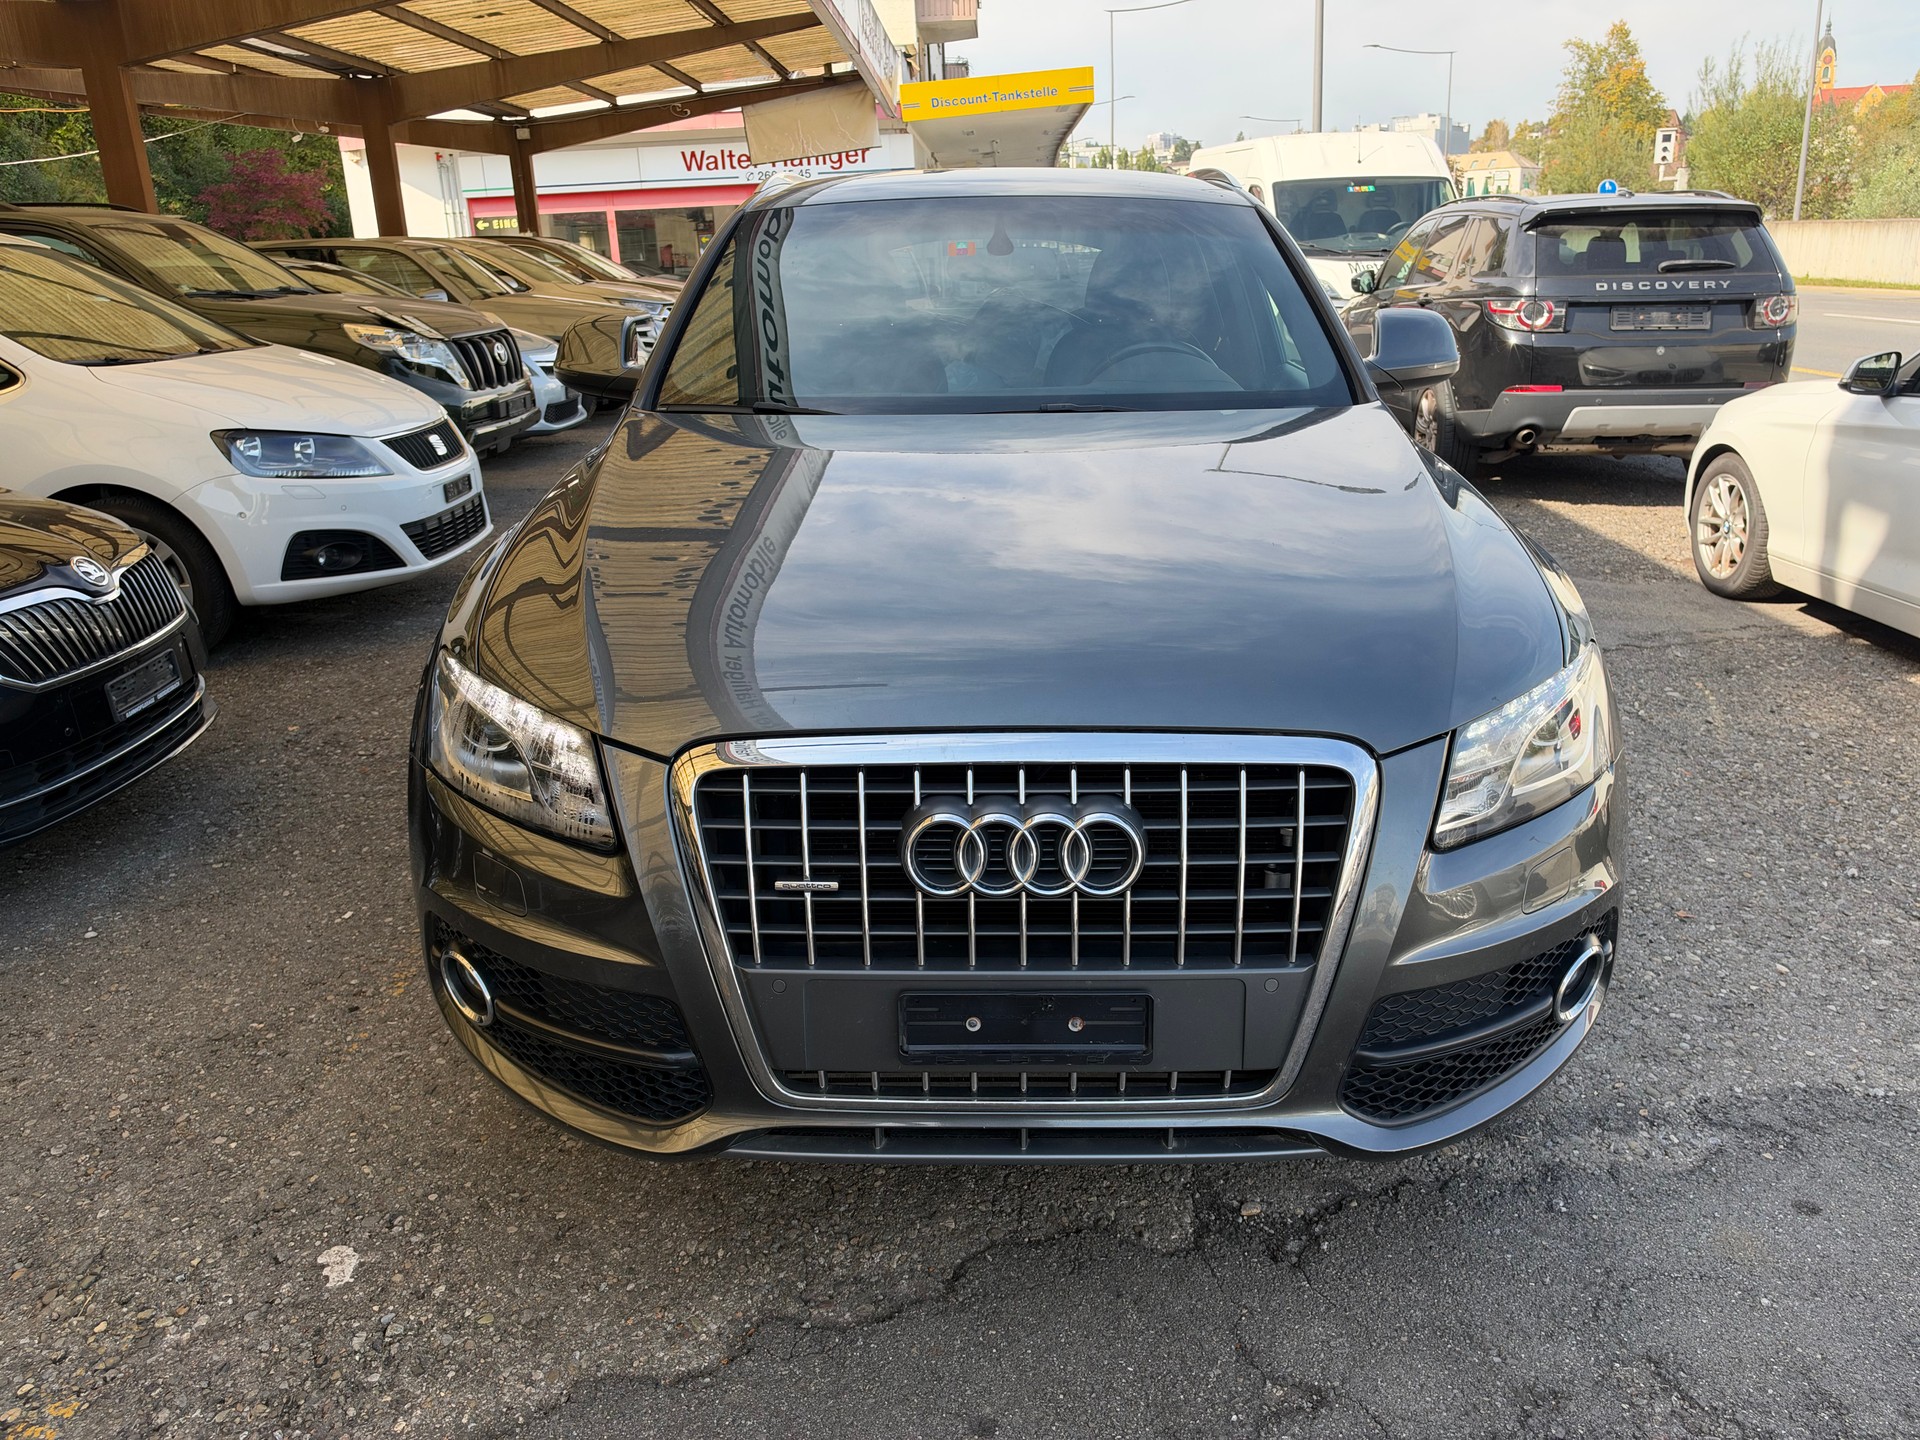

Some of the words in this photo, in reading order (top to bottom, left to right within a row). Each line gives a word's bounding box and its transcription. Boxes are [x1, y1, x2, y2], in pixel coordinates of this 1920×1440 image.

[931, 86, 1058, 108] Discount-Tankstelle
[680, 149, 757, 171] Walte
[492, 218, 518, 229] EING
[1595, 280, 1731, 291] DISCOVERY
[781, 882, 832, 891] quattro
